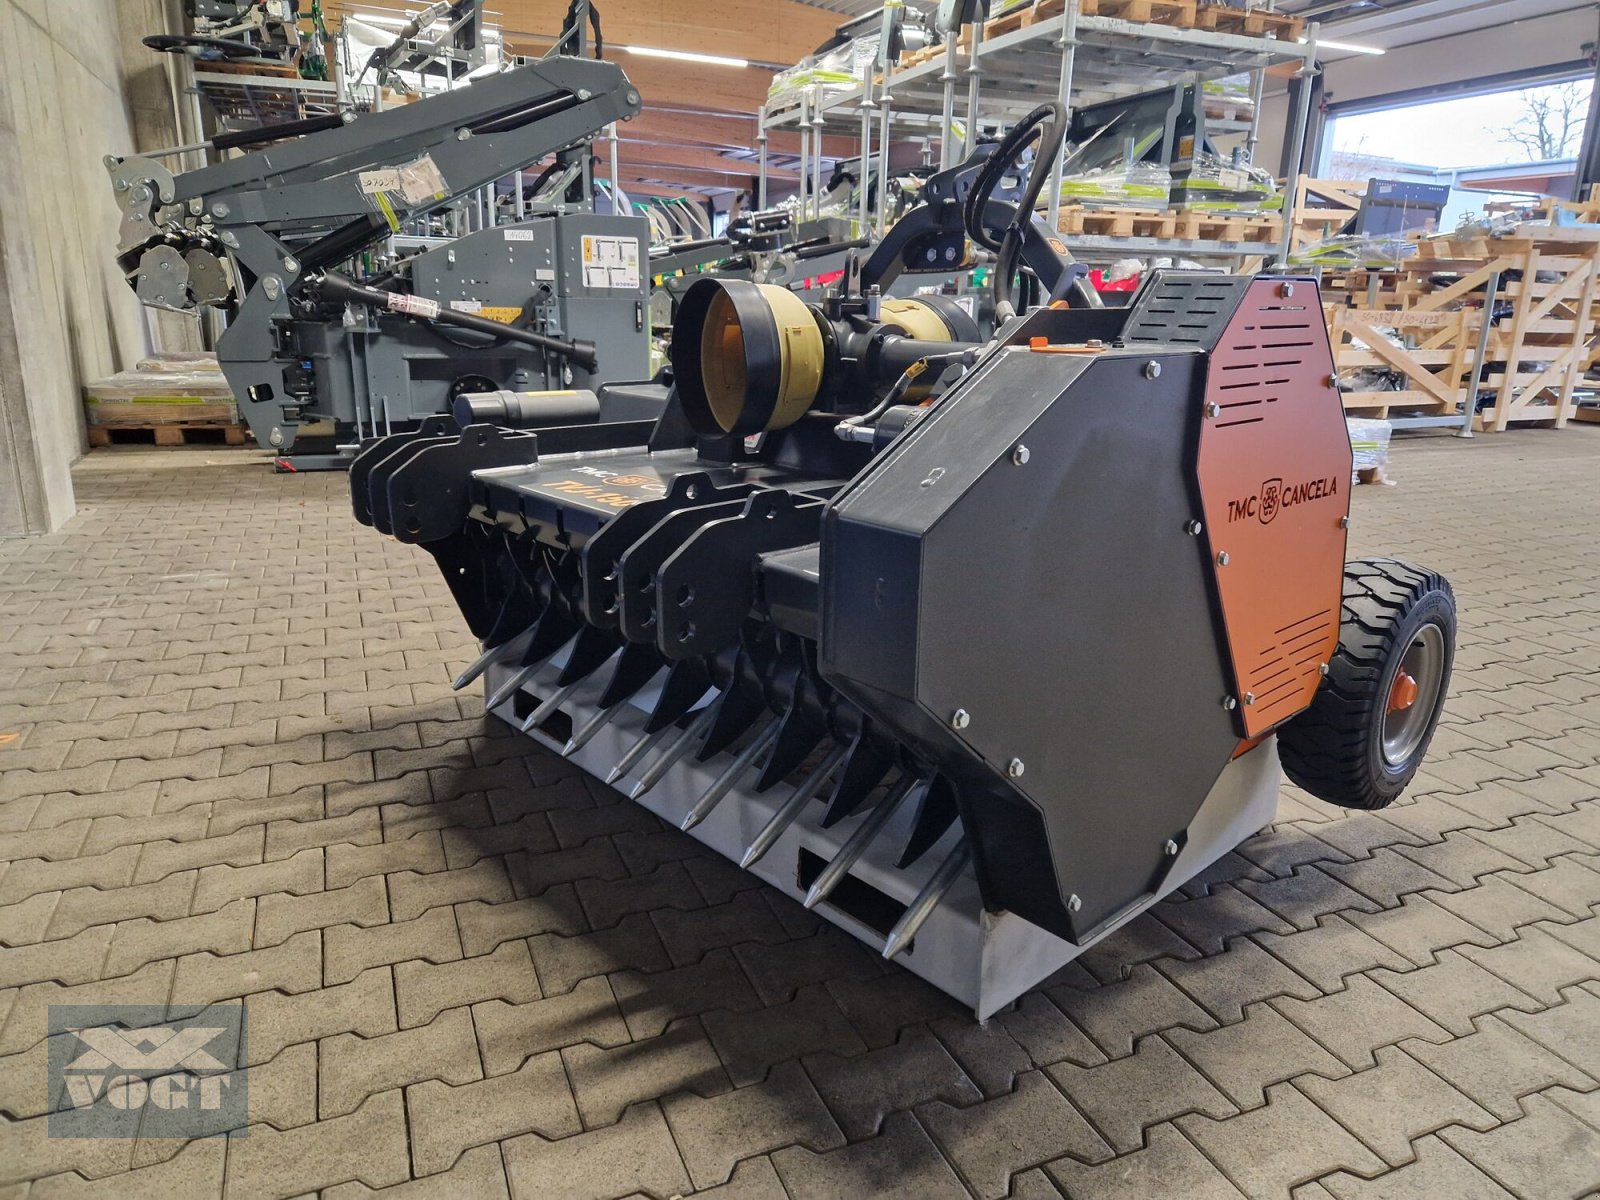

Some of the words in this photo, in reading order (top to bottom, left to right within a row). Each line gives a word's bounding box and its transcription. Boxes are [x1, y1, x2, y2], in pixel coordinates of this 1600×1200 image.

[570, 466, 619, 478] TMC
[1228, 495, 1257, 523] TMC
[1281, 476, 1337, 508] CANCELA
